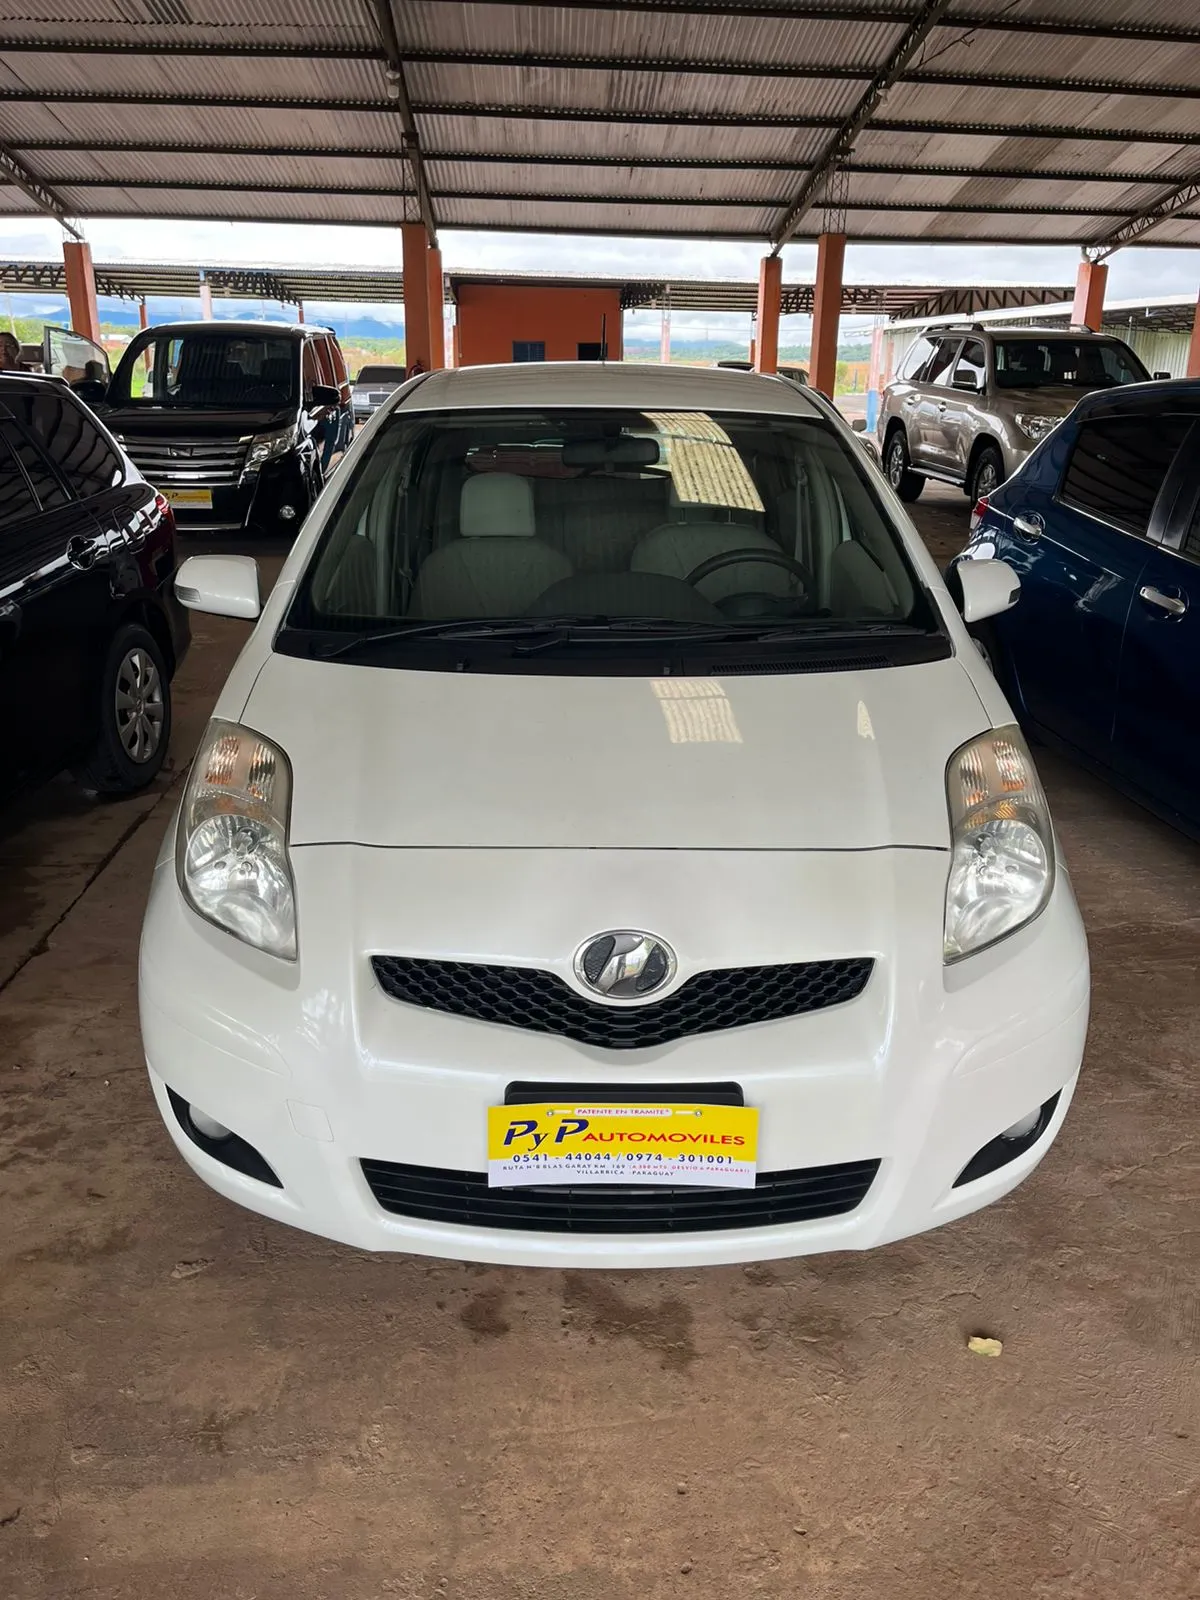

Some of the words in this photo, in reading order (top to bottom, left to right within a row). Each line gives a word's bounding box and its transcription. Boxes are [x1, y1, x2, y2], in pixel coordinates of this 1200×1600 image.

[582, 1132, 745, 1146] AUTOMOVILES
[512, 1153, 548, 1163] 0541
[565, 1152, 611, 1161] 44044
[626, 1153, 662, 1162] 0974
[678, 1154, 732, 1164] 301001
